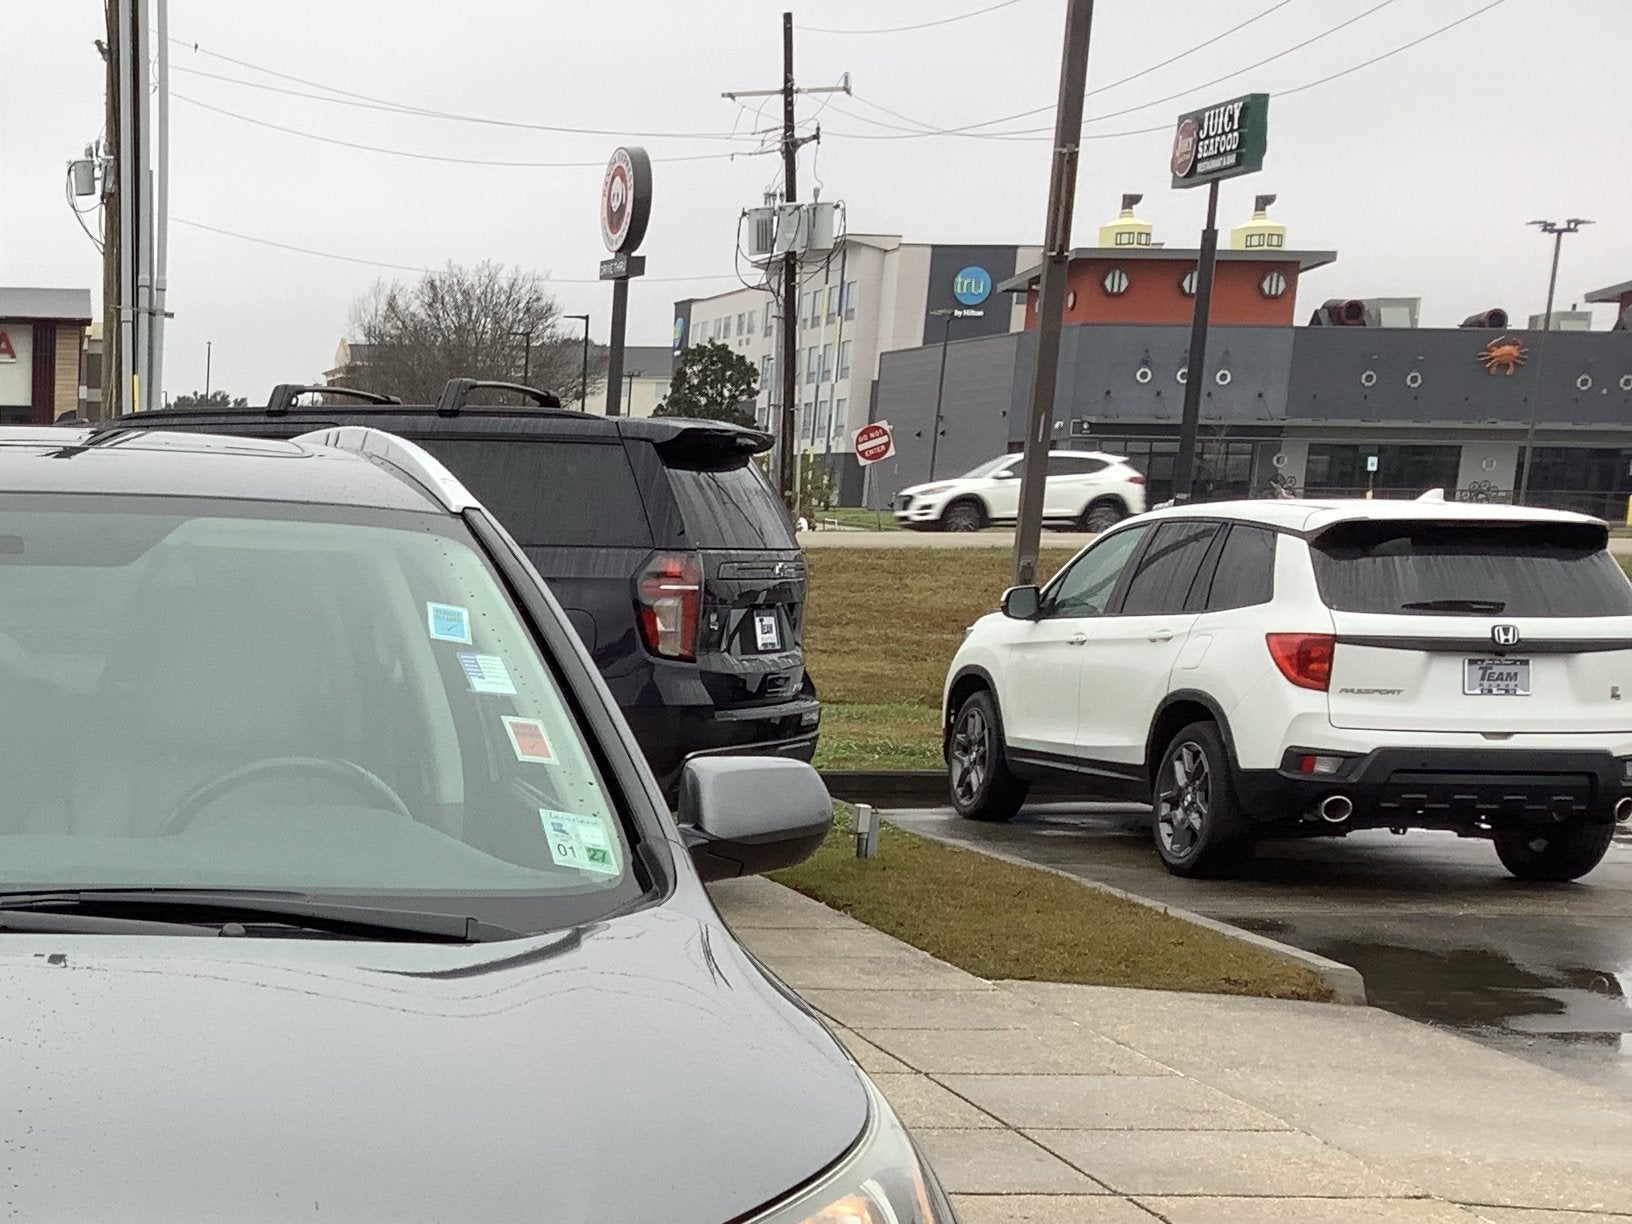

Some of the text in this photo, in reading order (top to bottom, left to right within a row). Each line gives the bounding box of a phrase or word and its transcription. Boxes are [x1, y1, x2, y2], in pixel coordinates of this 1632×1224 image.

[1200, 102, 1243, 139] JUICY
[1197, 132, 1239, 159] SEAFOOD
[954, 275, 984, 294] tru
[858, 429, 883, 442] DO NOT
[865, 445, 885, 457] ENTER
[1478, 665, 1519, 682] TEAM
[557, 843, 607, 864] 01 27
